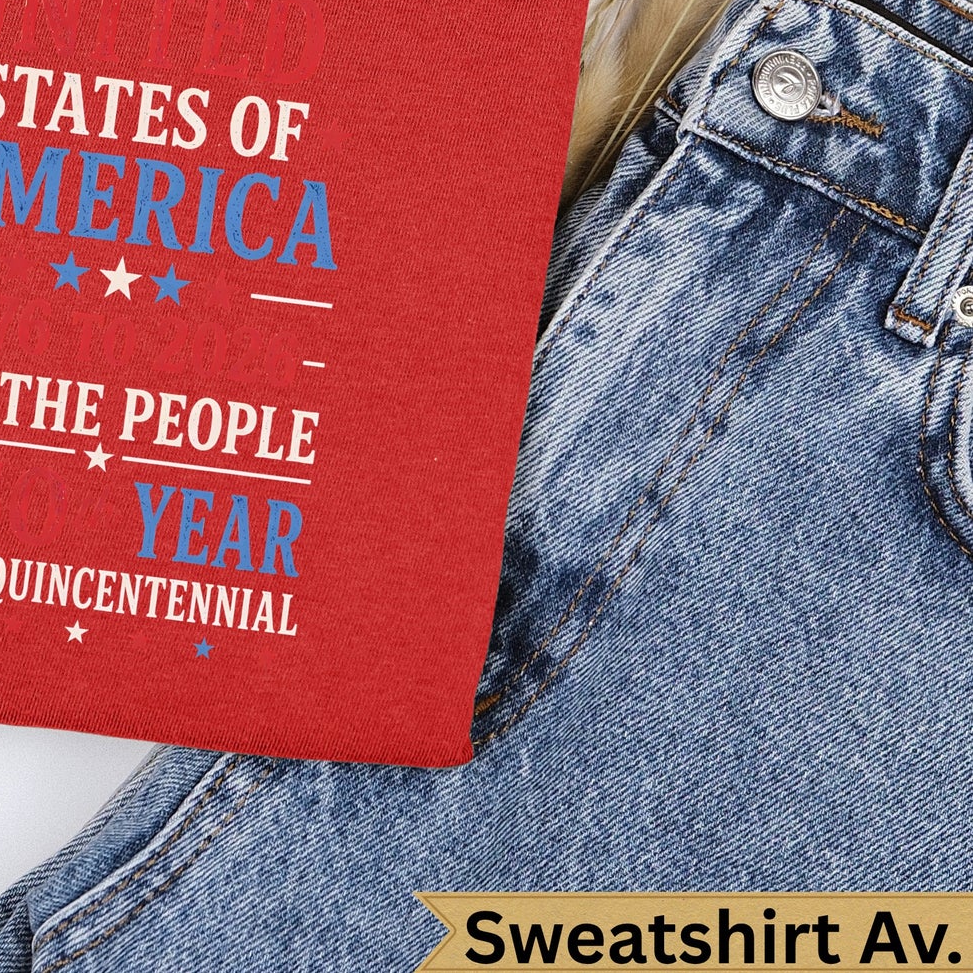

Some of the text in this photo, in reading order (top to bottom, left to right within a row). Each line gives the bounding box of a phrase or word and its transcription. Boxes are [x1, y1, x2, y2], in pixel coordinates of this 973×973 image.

[229, 95, 310, 162] OF
[0, 372, 105, 436] THE
[119, 387, 320, 465] PEOPLE
[134, 482, 304, 578] YEAR
